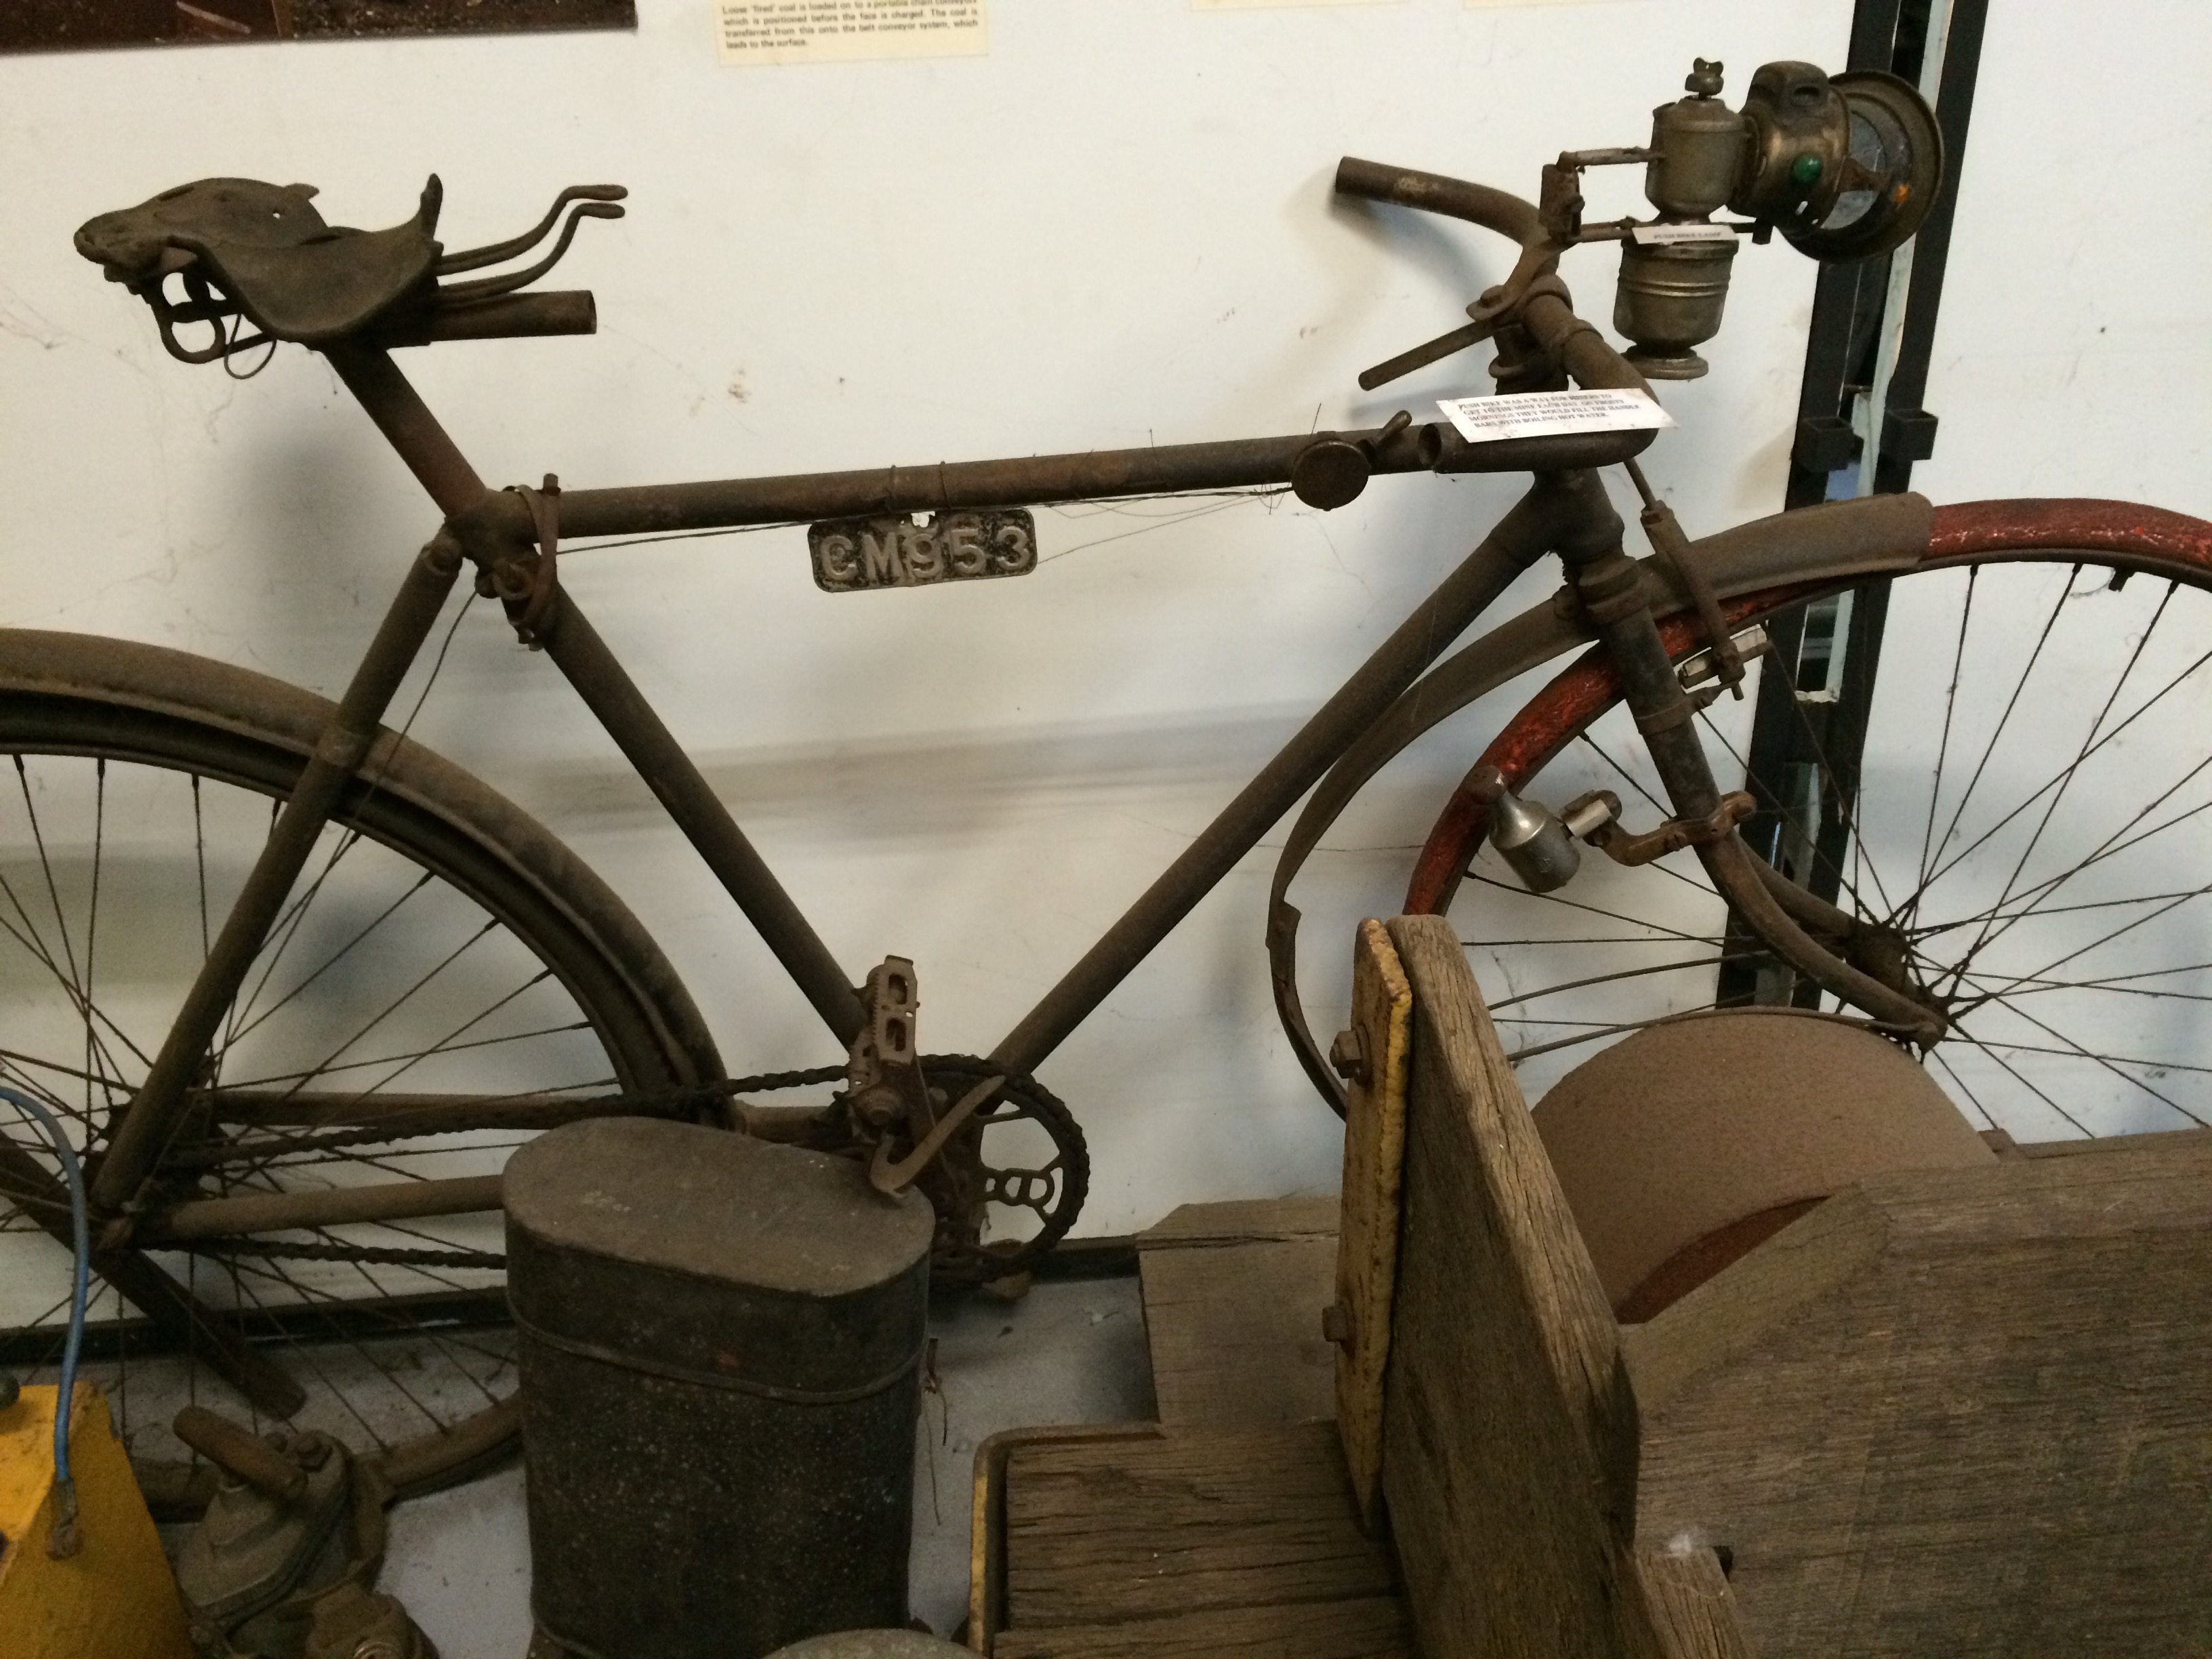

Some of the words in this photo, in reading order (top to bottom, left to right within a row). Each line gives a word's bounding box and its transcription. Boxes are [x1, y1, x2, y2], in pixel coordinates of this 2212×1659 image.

[779, 4, 796, 12] coal
[809, 2, 837, 11] loaded
[855, 1, 863, 9] to
[874, 0, 908, 9] portable
[724, 17, 748, 26] which
[763, 15, 807, 26] positioned
[811, 14, 838, 22] before
[842, 12, 856, 20] the
[860, 12, 877, 20] face
[931, 8, 946, 16] The
[949, 7, 966, 16] coal
[971, 7, 978, 15] is
[725, 28, 771, 37] transferred
[775, 28, 795, 36] from
[799, 26, 815, 35] this
[818, 26, 838, 34] onto
[842, 24, 856, 33] the
[859, 23, 875, 32] belt
[878, 22, 916, 31] conveyor
[920, 21, 950, 30] system,
[954, 19, 978, 27] which
[726, 41, 747, 49] leads
[761, 39, 774, 47] the
[1469, 413, 1515, 422] MORNINGS
